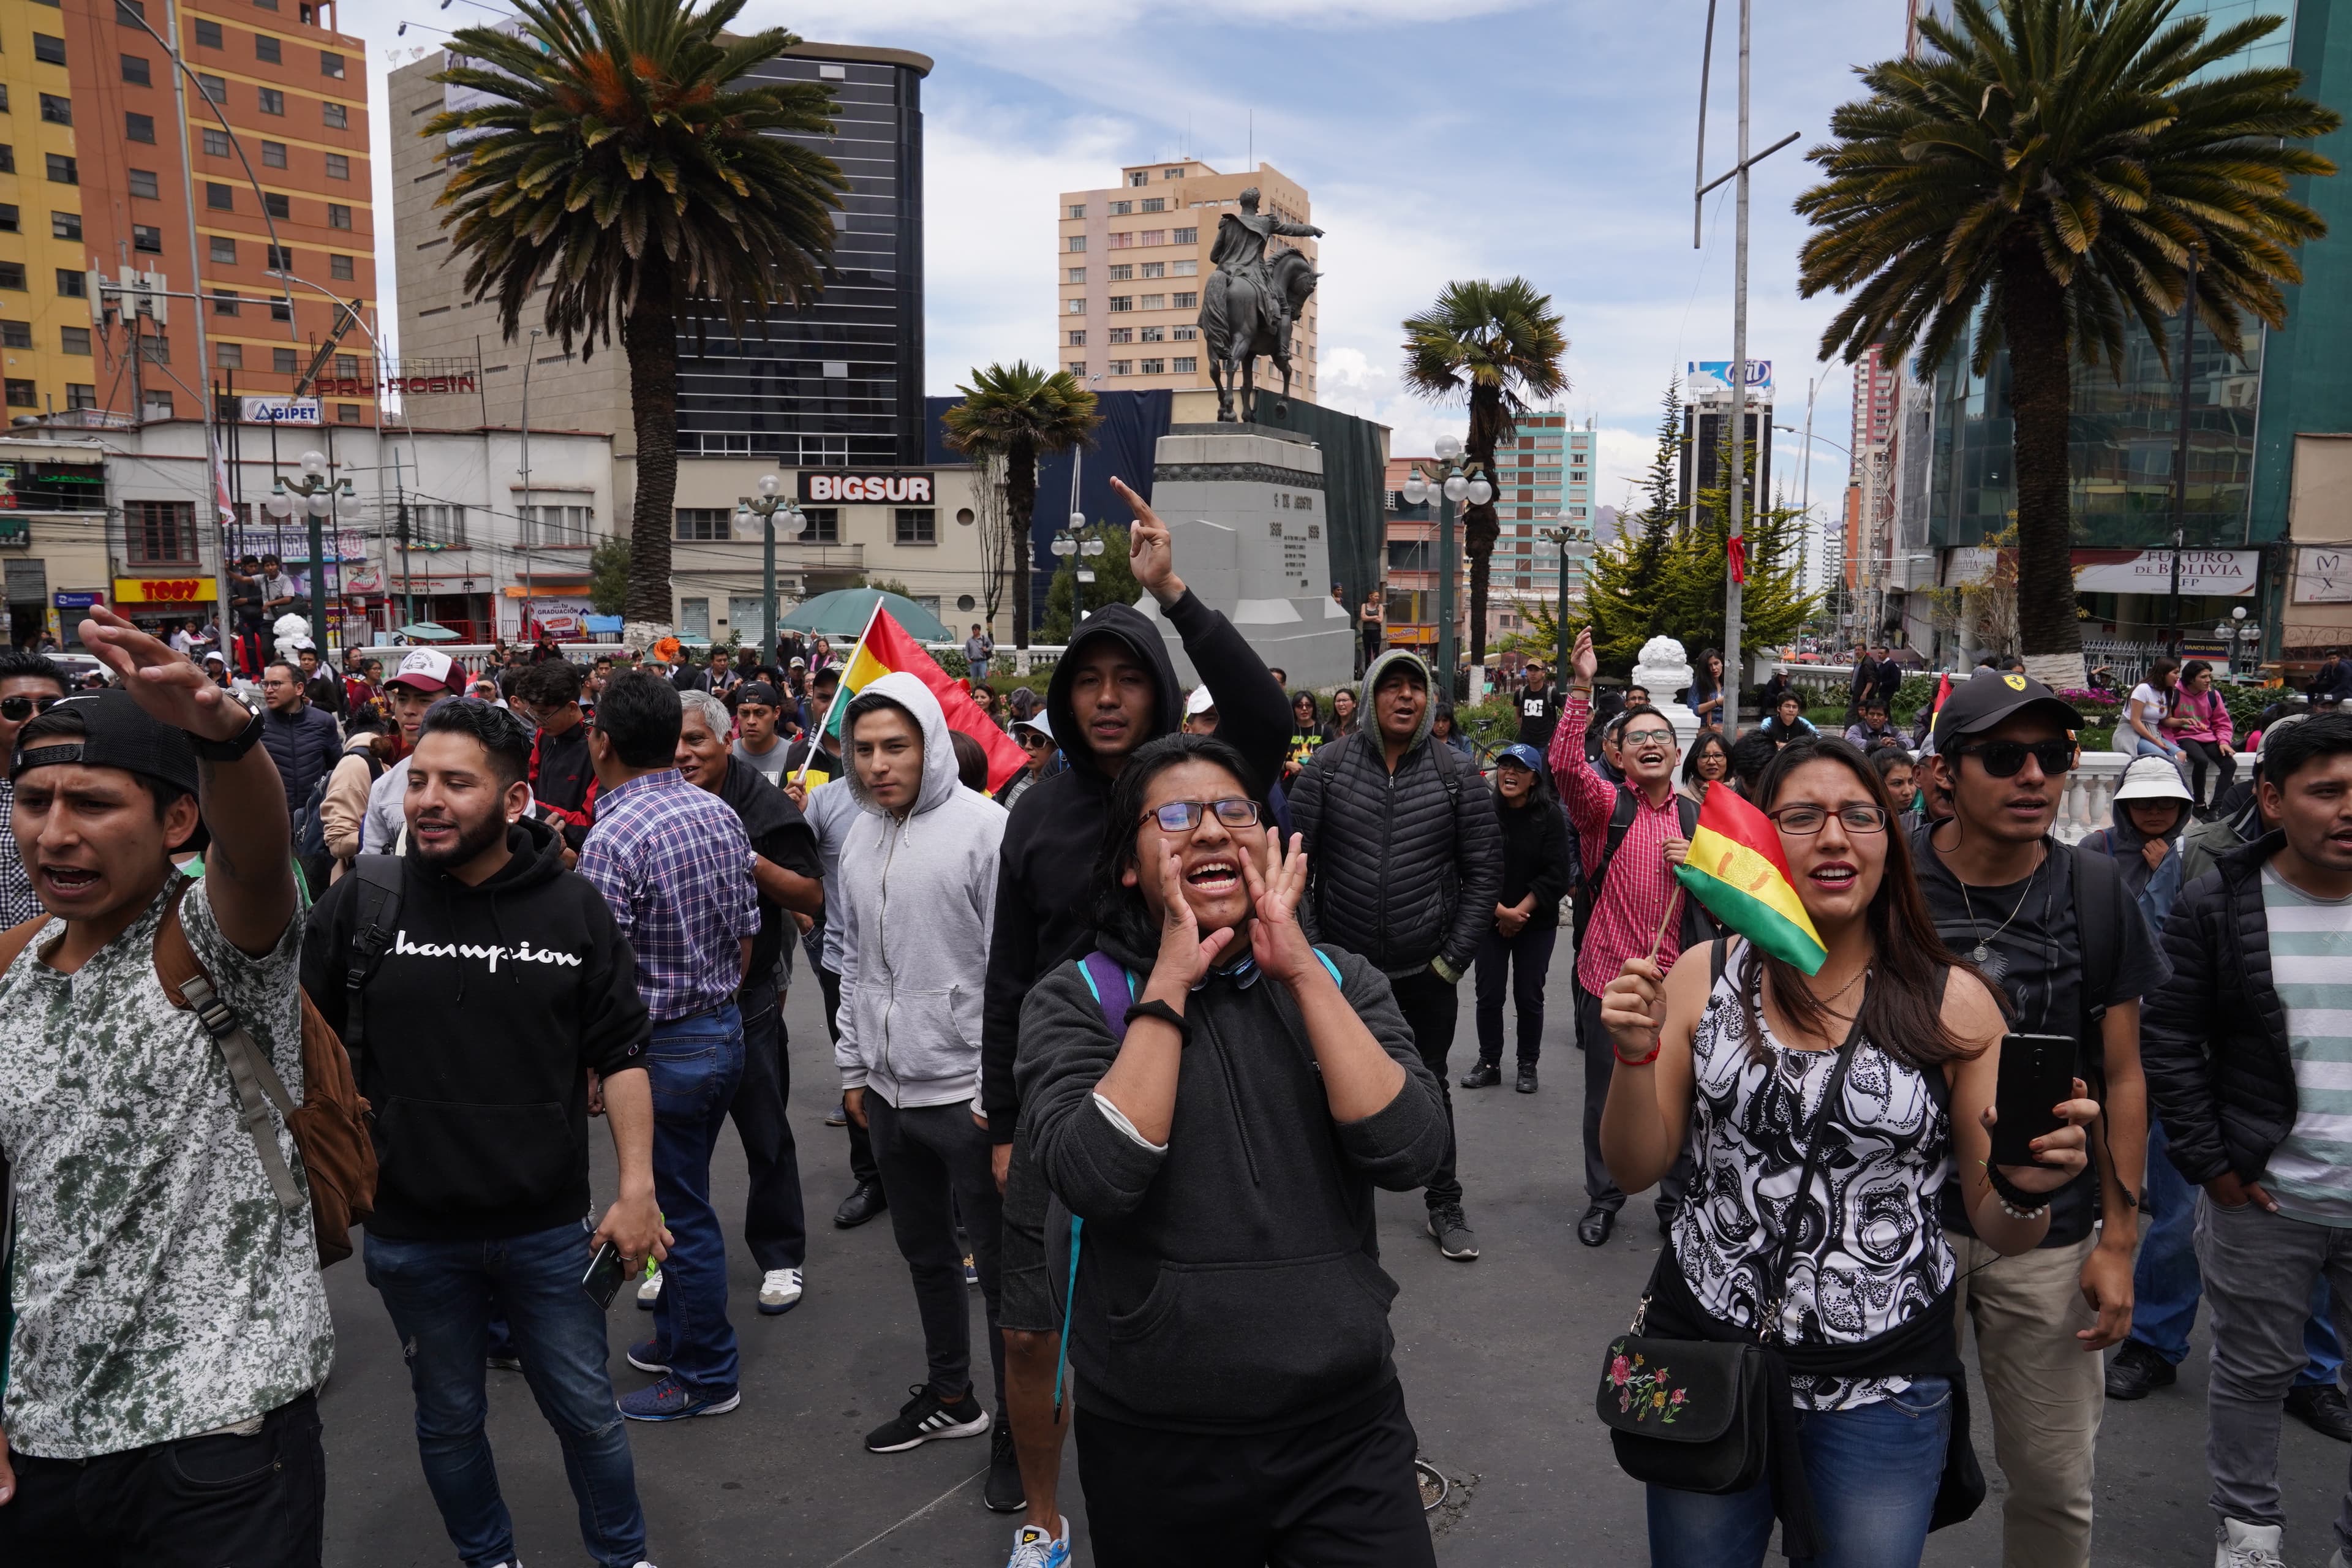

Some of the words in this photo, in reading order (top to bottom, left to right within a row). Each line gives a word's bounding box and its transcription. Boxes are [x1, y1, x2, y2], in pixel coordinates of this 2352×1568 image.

[1732, 360, 1760, 381] il
[810, 475, 930, 501] BIGSUR
[2147, 552, 2234, 563] FUURO
[141, 579, 200, 601] TOBY
[384, 929, 582, 973] hampion
